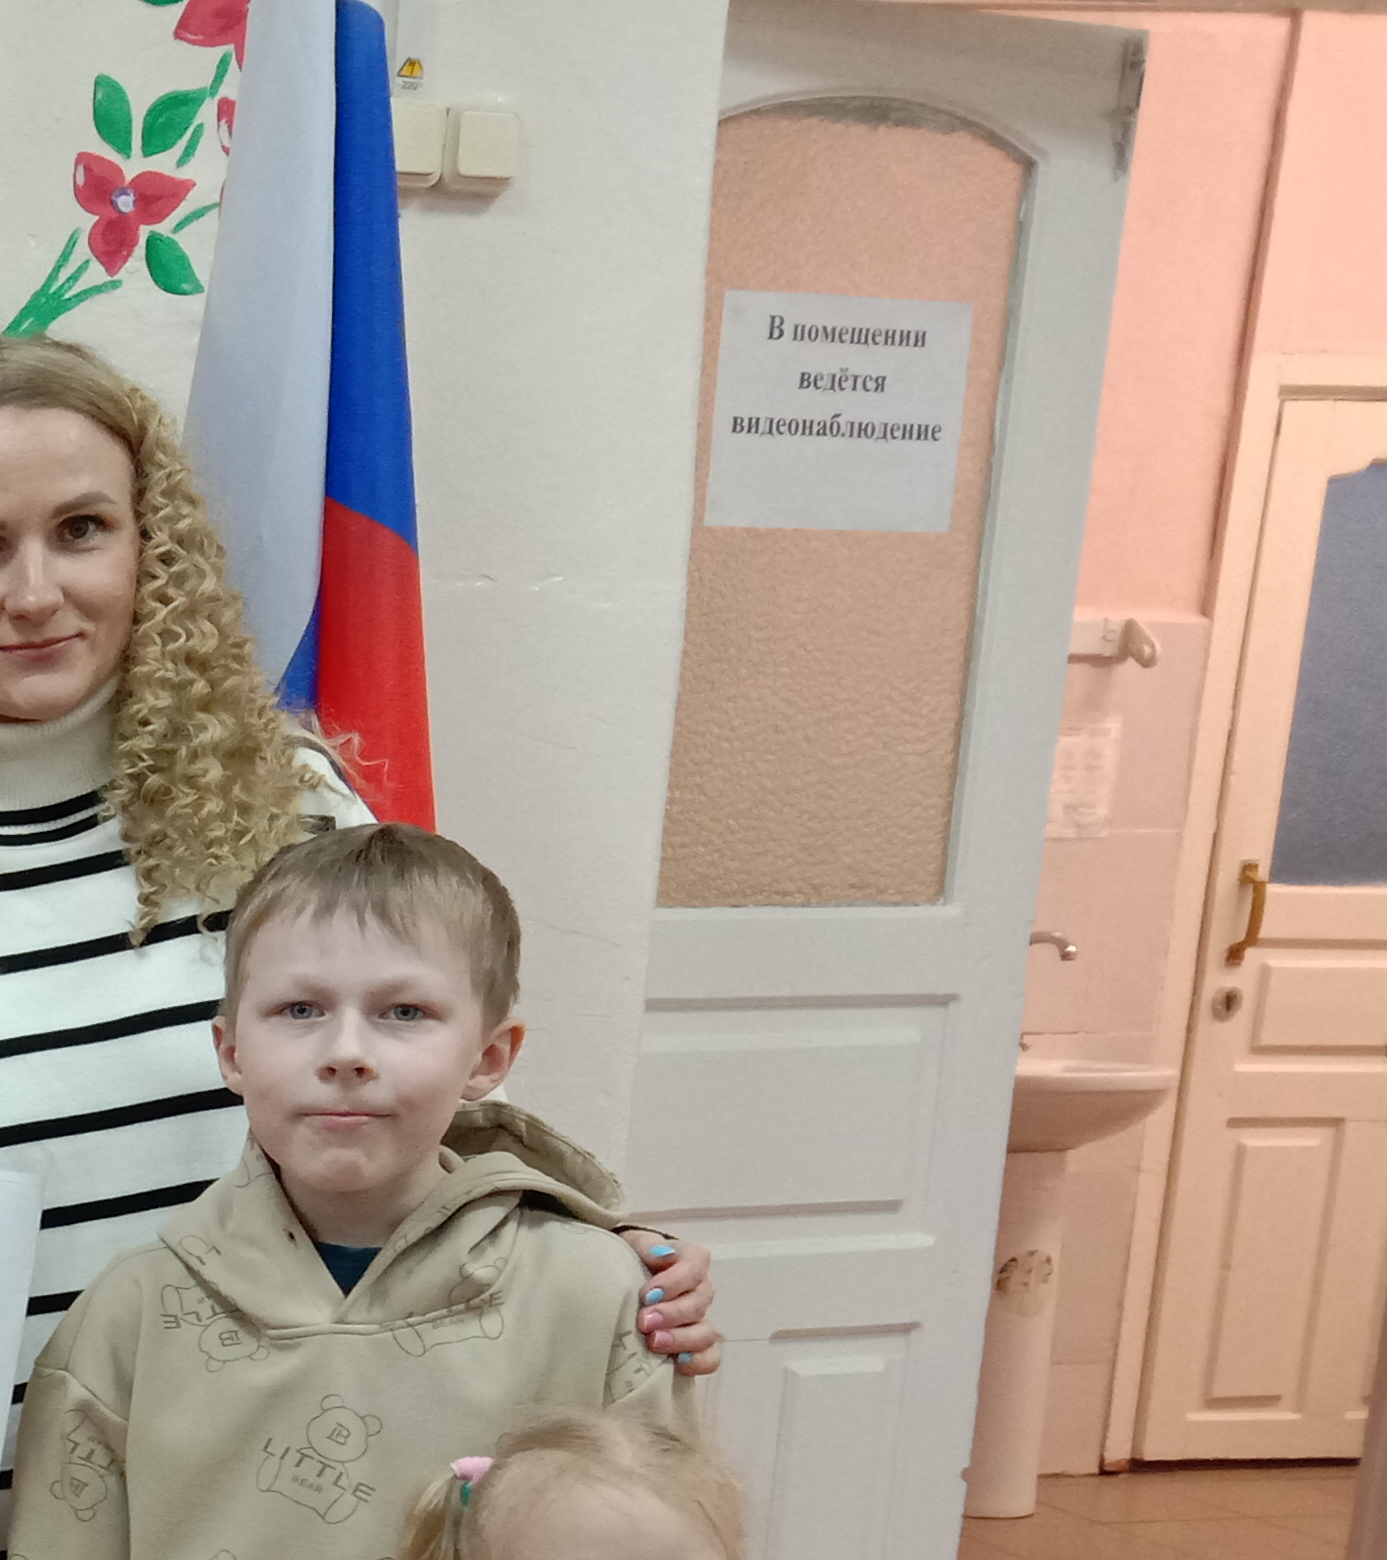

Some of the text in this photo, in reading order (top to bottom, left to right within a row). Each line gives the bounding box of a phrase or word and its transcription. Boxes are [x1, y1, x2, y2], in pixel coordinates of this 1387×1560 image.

[766, 313, 928, 349] В помещении
[797, 367, 888, 394] ведётся
[730, 412, 943, 443] видеонаблюдение
[262, 1437, 377, 1504] LITTLE
